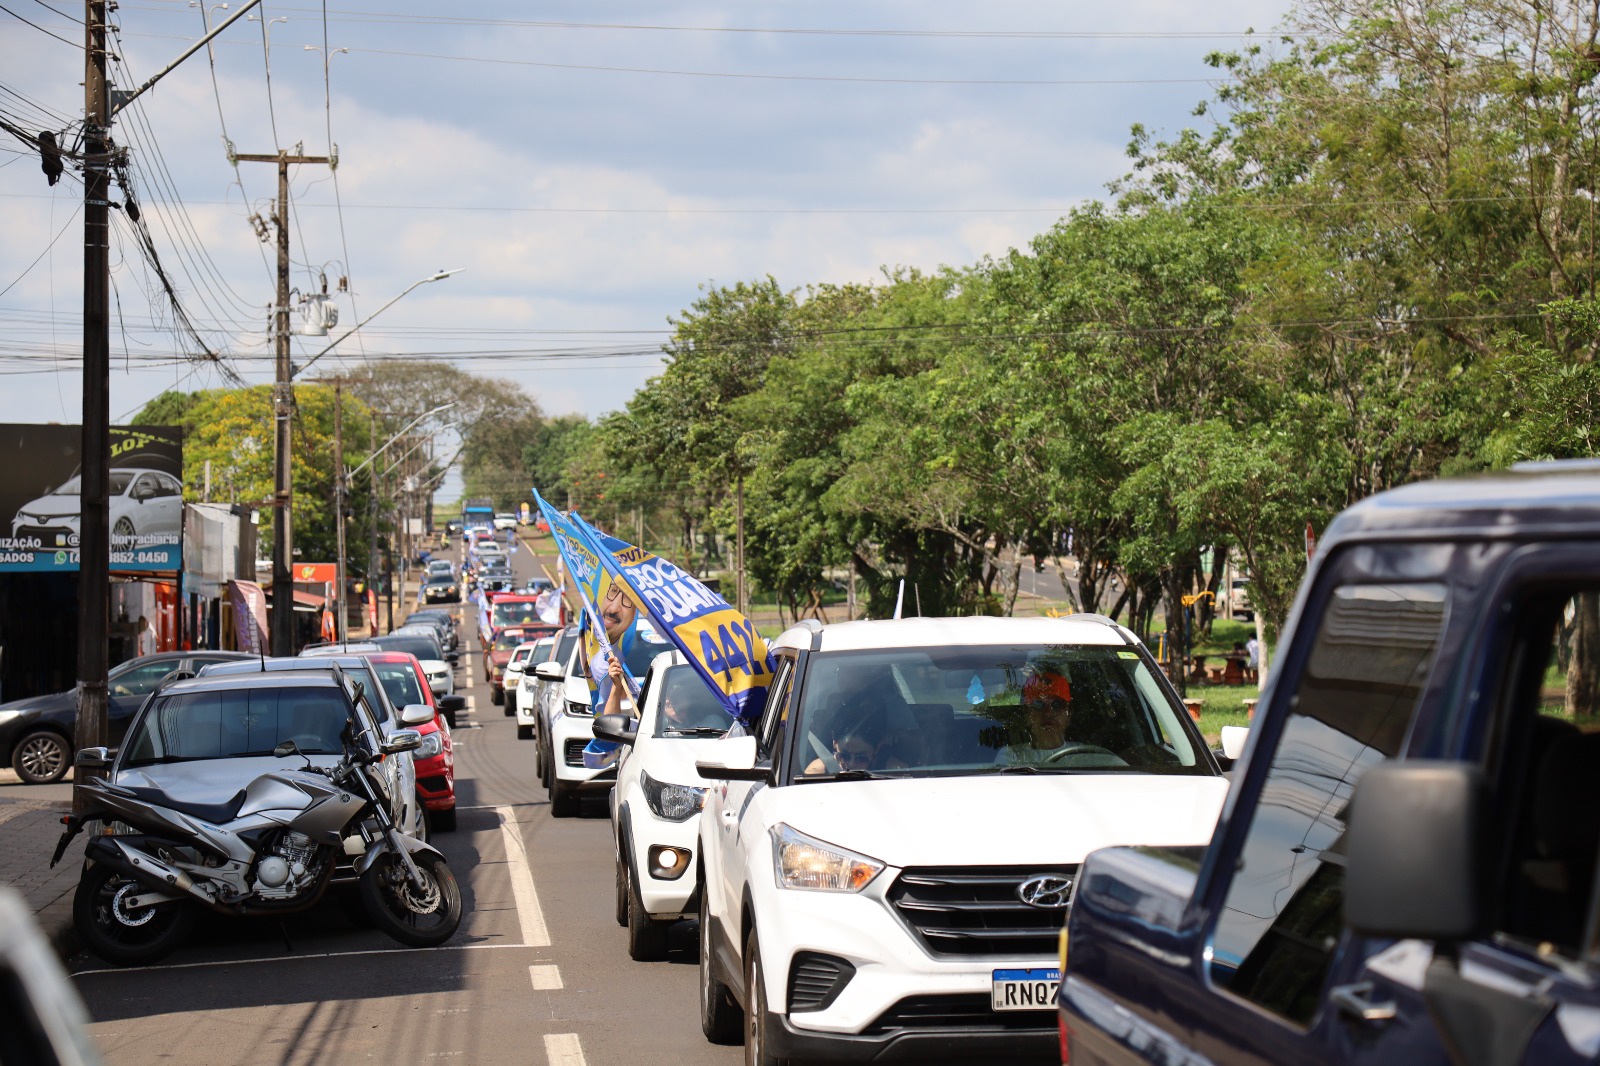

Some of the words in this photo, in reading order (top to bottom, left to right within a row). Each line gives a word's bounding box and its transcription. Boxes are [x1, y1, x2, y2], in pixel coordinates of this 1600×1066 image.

[110, 438, 150, 457] LOP
[0, 536, 42, 551] IZAÇÃO
[0, 552, 35, 563] SADOS
[1004, 982, 1060, 1005] RNQ7
